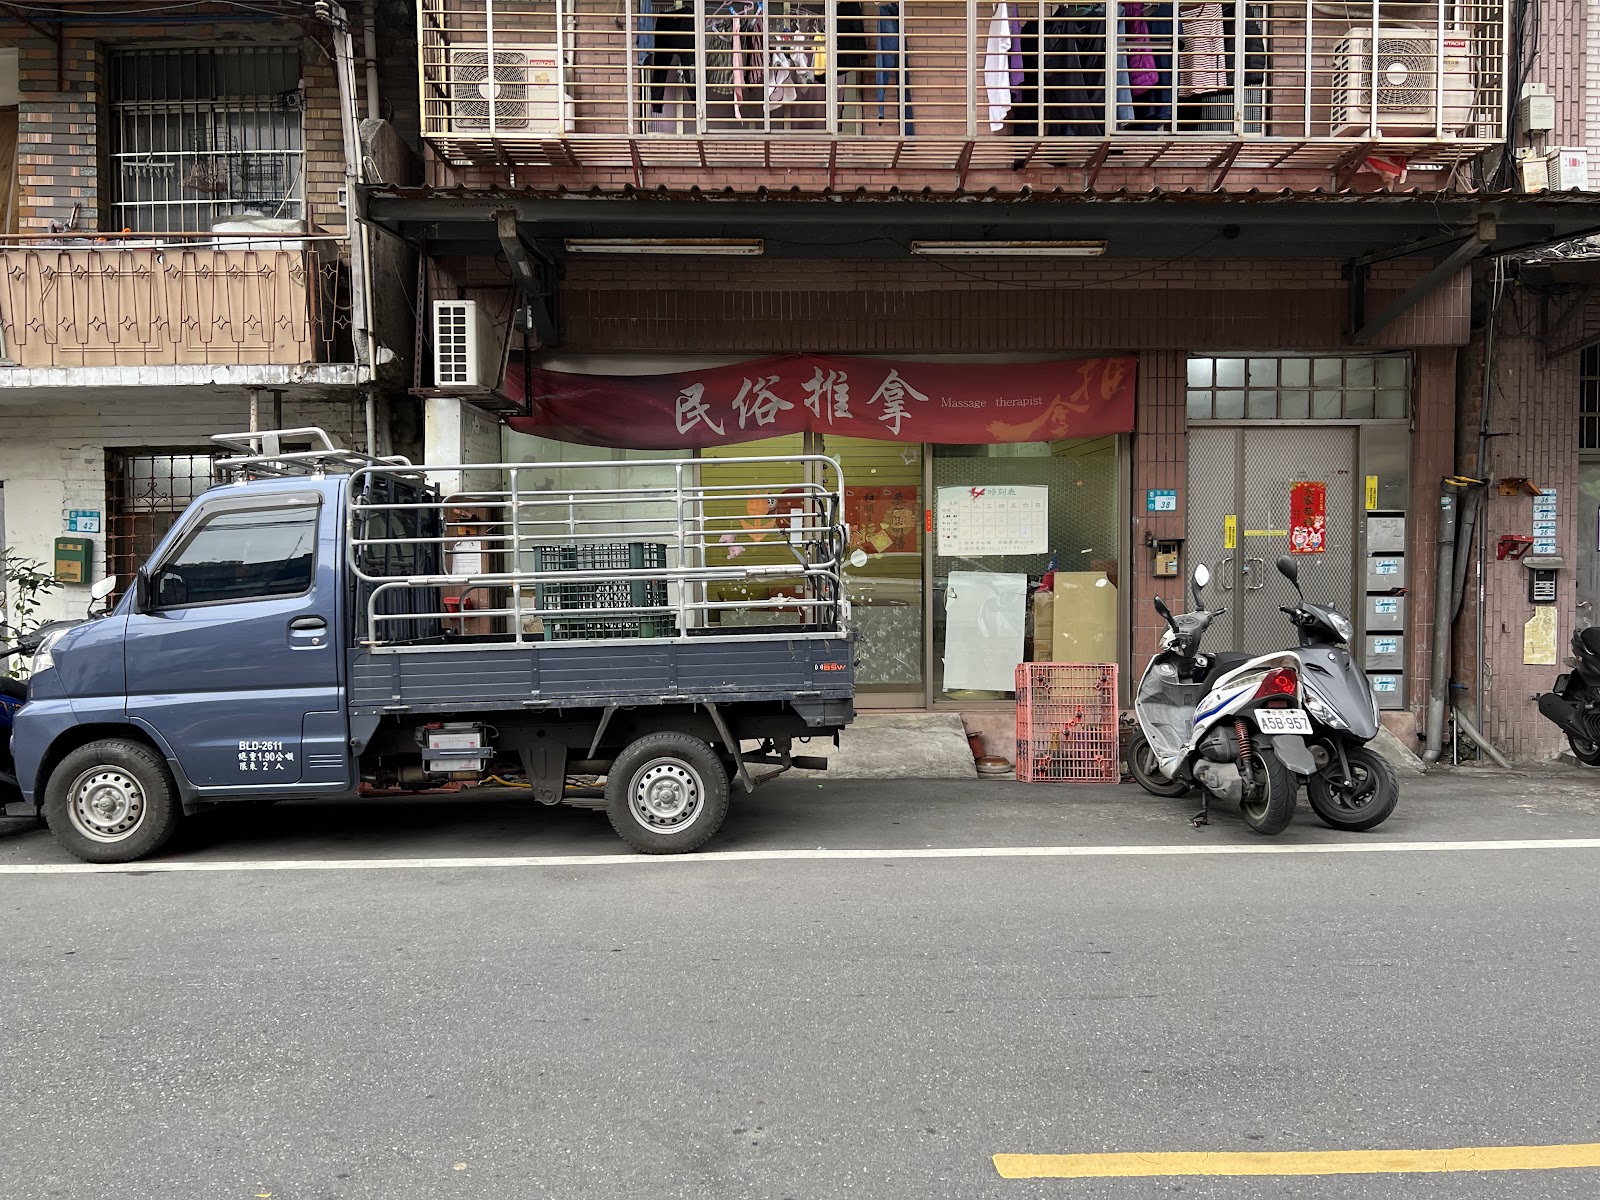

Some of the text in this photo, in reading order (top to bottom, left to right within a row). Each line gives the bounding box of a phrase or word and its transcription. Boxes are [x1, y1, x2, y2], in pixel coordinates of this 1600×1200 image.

[675, 365, 929, 436] 民俗推拿
[941, 395, 1043, 409] Massage therapist
[1160, 501, 1171, 509] 38
[83, 522, 94, 530] 42
[239, 741, 282, 750] BLD-2611
